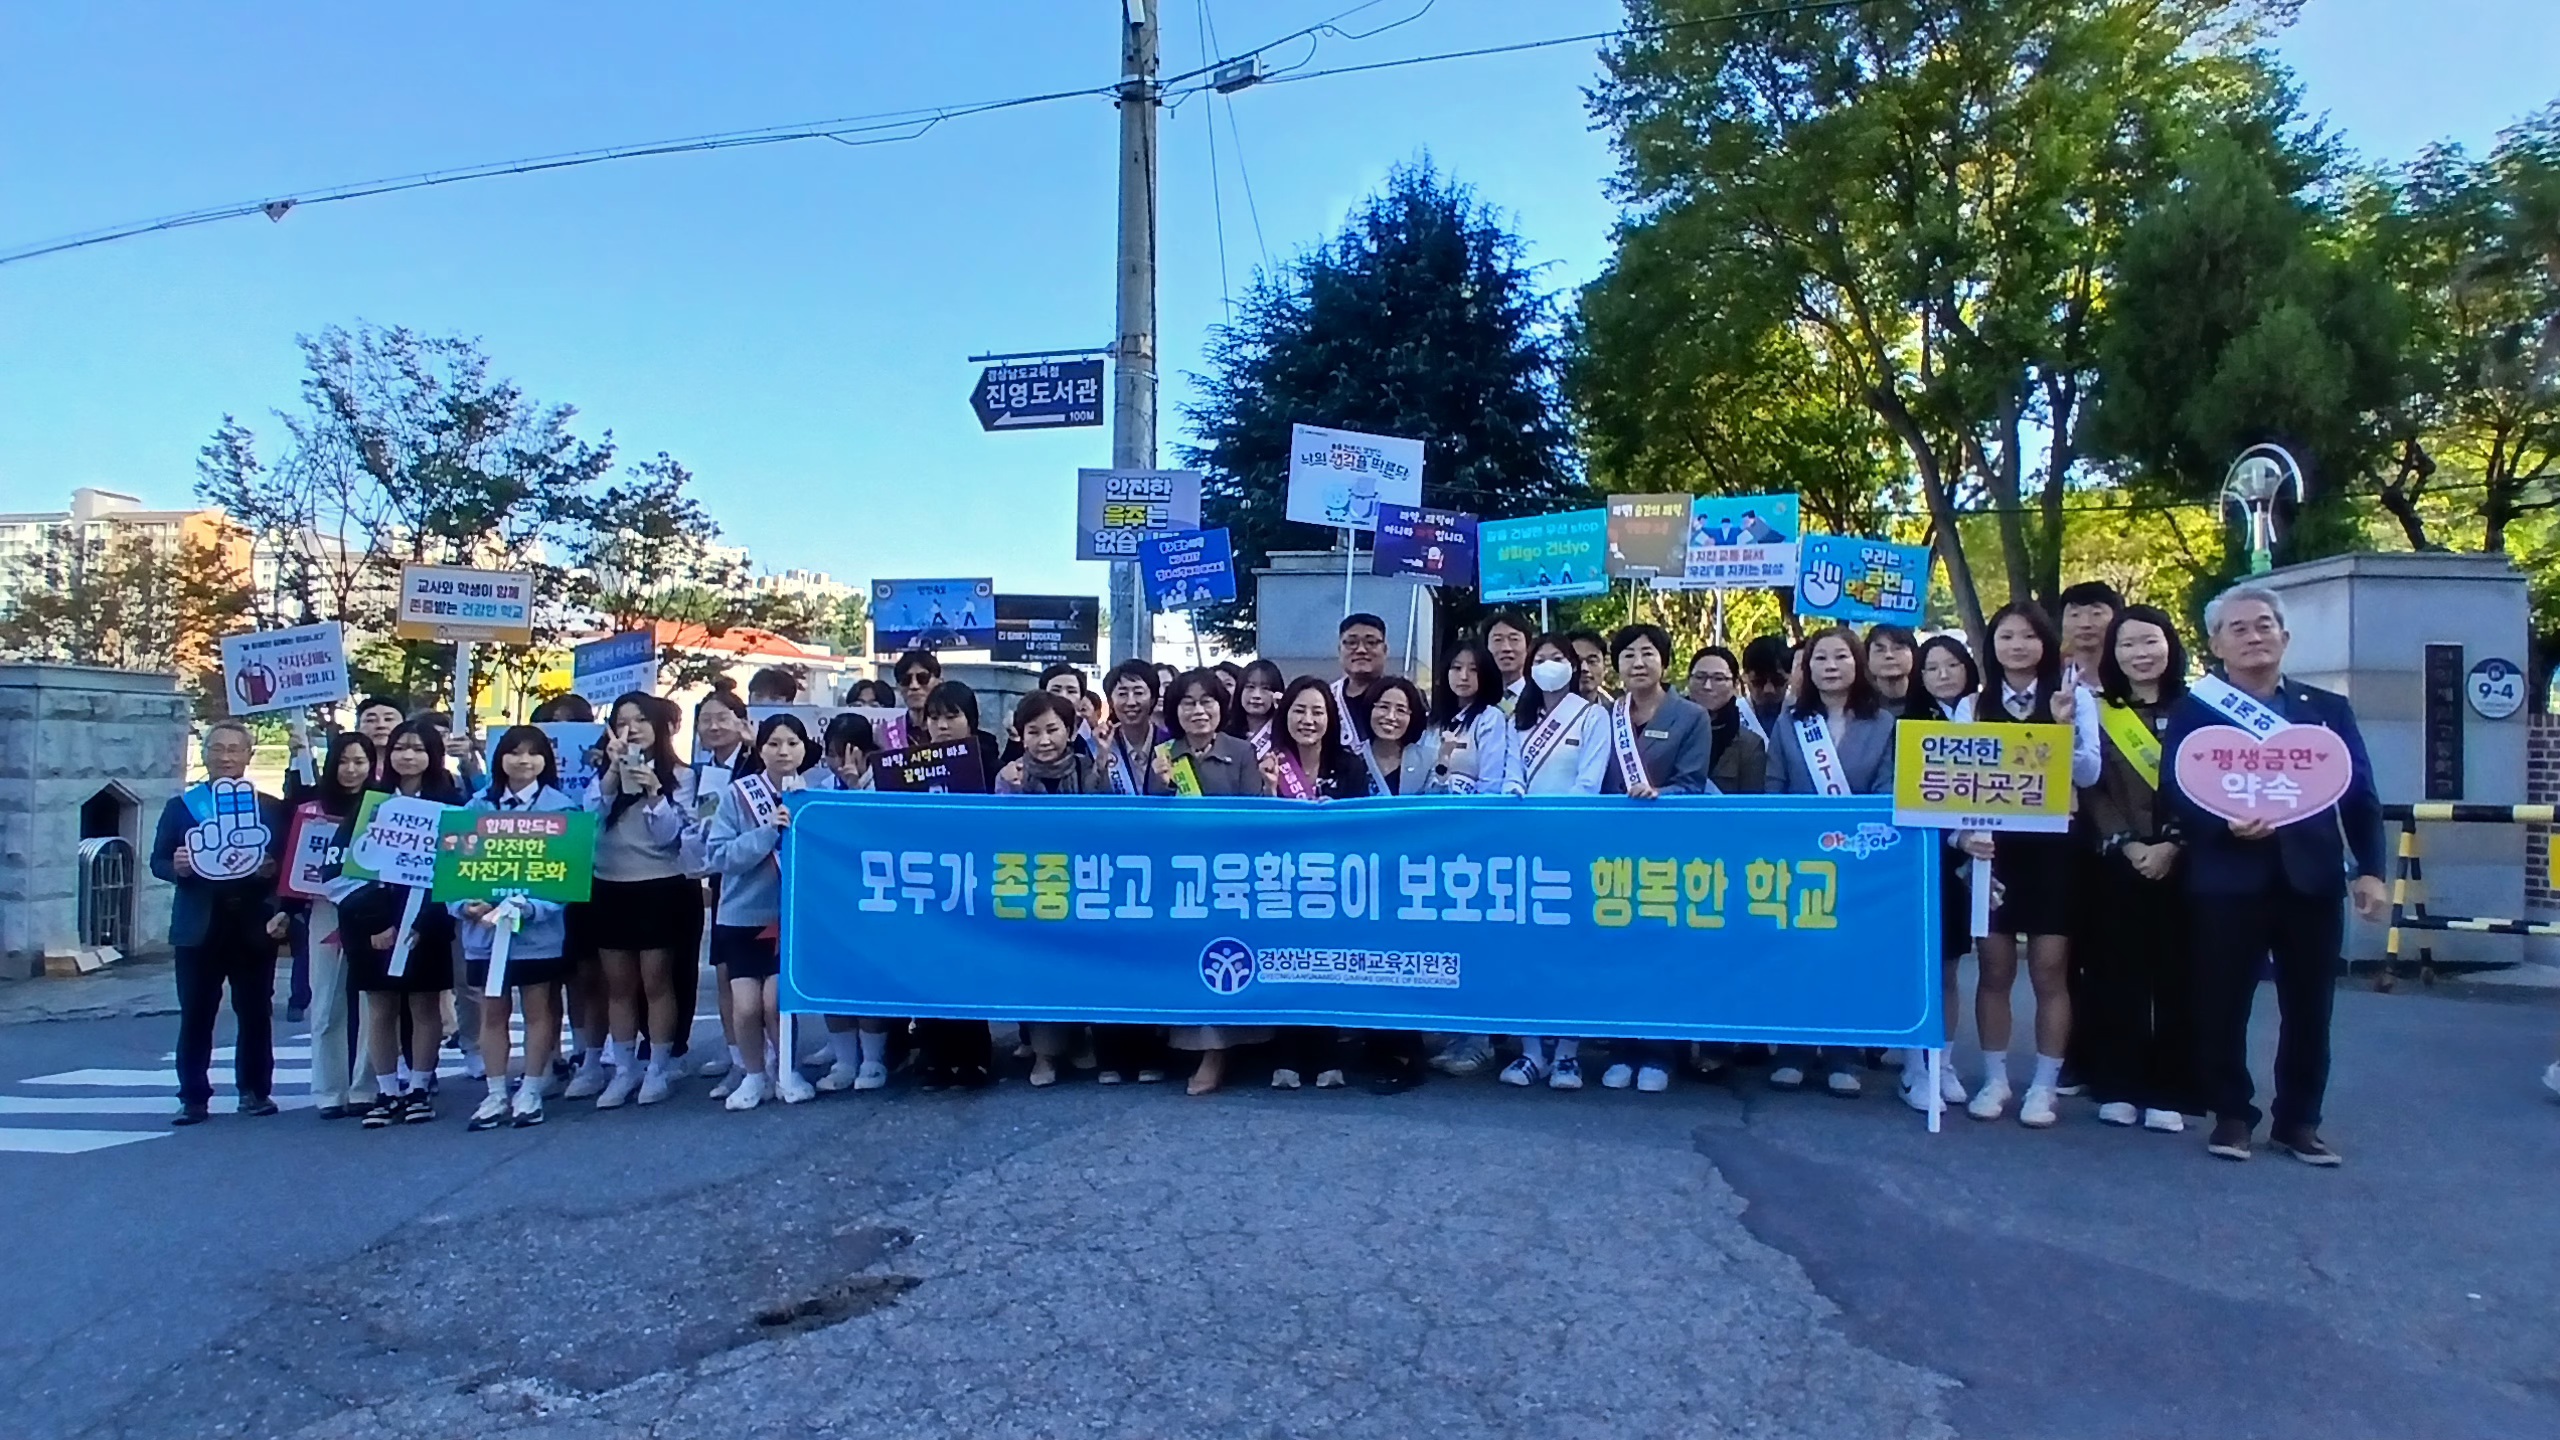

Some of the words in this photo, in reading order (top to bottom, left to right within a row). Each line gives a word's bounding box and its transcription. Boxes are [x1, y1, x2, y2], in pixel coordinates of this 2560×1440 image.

[987, 365, 1060, 382] 경상남도교육청
[986, 378, 1098, 409] 진영도서관
[1069, 411, 1095, 422] 100M
[1106, 478, 1172, 502] 안전한
[1103, 504, 1168, 529] 음주는
[1571, 520, 1600, 533] stop
[1861, 547, 1900, 566] 우리는
[1727, 563, 1760, 577] 지키는
[417, 578, 454, 595] 교사와
[457, 581, 493, 598] 학생이
[496, 585, 520, 599] 함께
[410, 598, 458, 615] 존중받는
[461, 602, 497, 618] 건강한
[500, 604, 523, 619] 학교
[2478, 682, 2514, 700] 9-4
[911, 748, 943, 762] 시작이
[946, 743, 968, 756] 바로
[1922, 737, 2002, 766] 안전한
[2211, 748, 2314, 771] 평생금연
[904, 764, 951, 783] 끝입니다.
[1919, 770, 2044, 806] 등하굣길
[2221, 772, 2302, 809] 약속
[743, 779, 773, 826] 함께하
[389, 812, 434, 832] 자전거
[486, 819, 514, 834] 함께
[517, 819, 559, 835] 만드는
[366, 827, 420, 851] 자전거
[484, 838, 546, 859] 안전한
[457, 861, 519, 882] 자전거
[524, 861, 567, 882] 문화
[858, 851, 978, 916] 모두가
[990, 852, 1154, 920] 존중받고
[1170, 851, 1380, 921] 교육활동이
[1397, 852, 1573, 925] 보호되는
[1590, 856, 1729, 929] 행복한
[1745, 857, 1838, 930] 학교
[1259, 949, 1459, 975] 경상남도김해교육지원청
[1375, 975, 1400, 984] OFFICE
[1402, 976, 1412, 984] OF
[1413, 977, 1458, 986] EDUCATION
